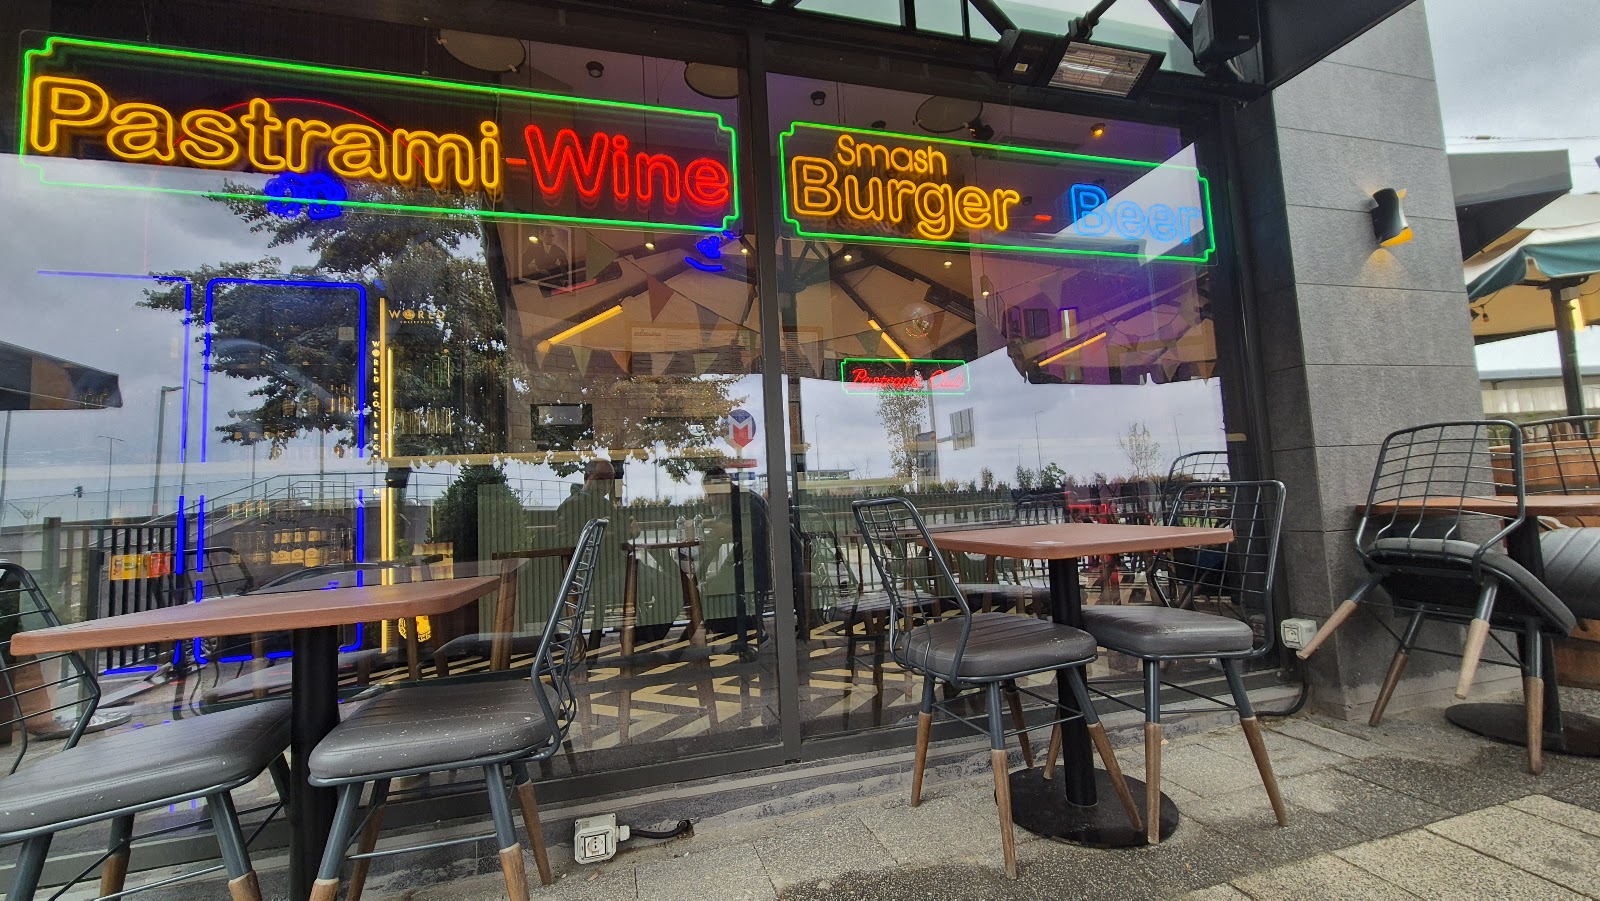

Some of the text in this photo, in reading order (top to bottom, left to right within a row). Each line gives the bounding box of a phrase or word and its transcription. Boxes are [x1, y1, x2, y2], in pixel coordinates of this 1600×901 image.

[836, 134, 948, 176] Smash
[791, 155, 1021, 240] Burger
[1070, 182, 1201, 245] Beer
